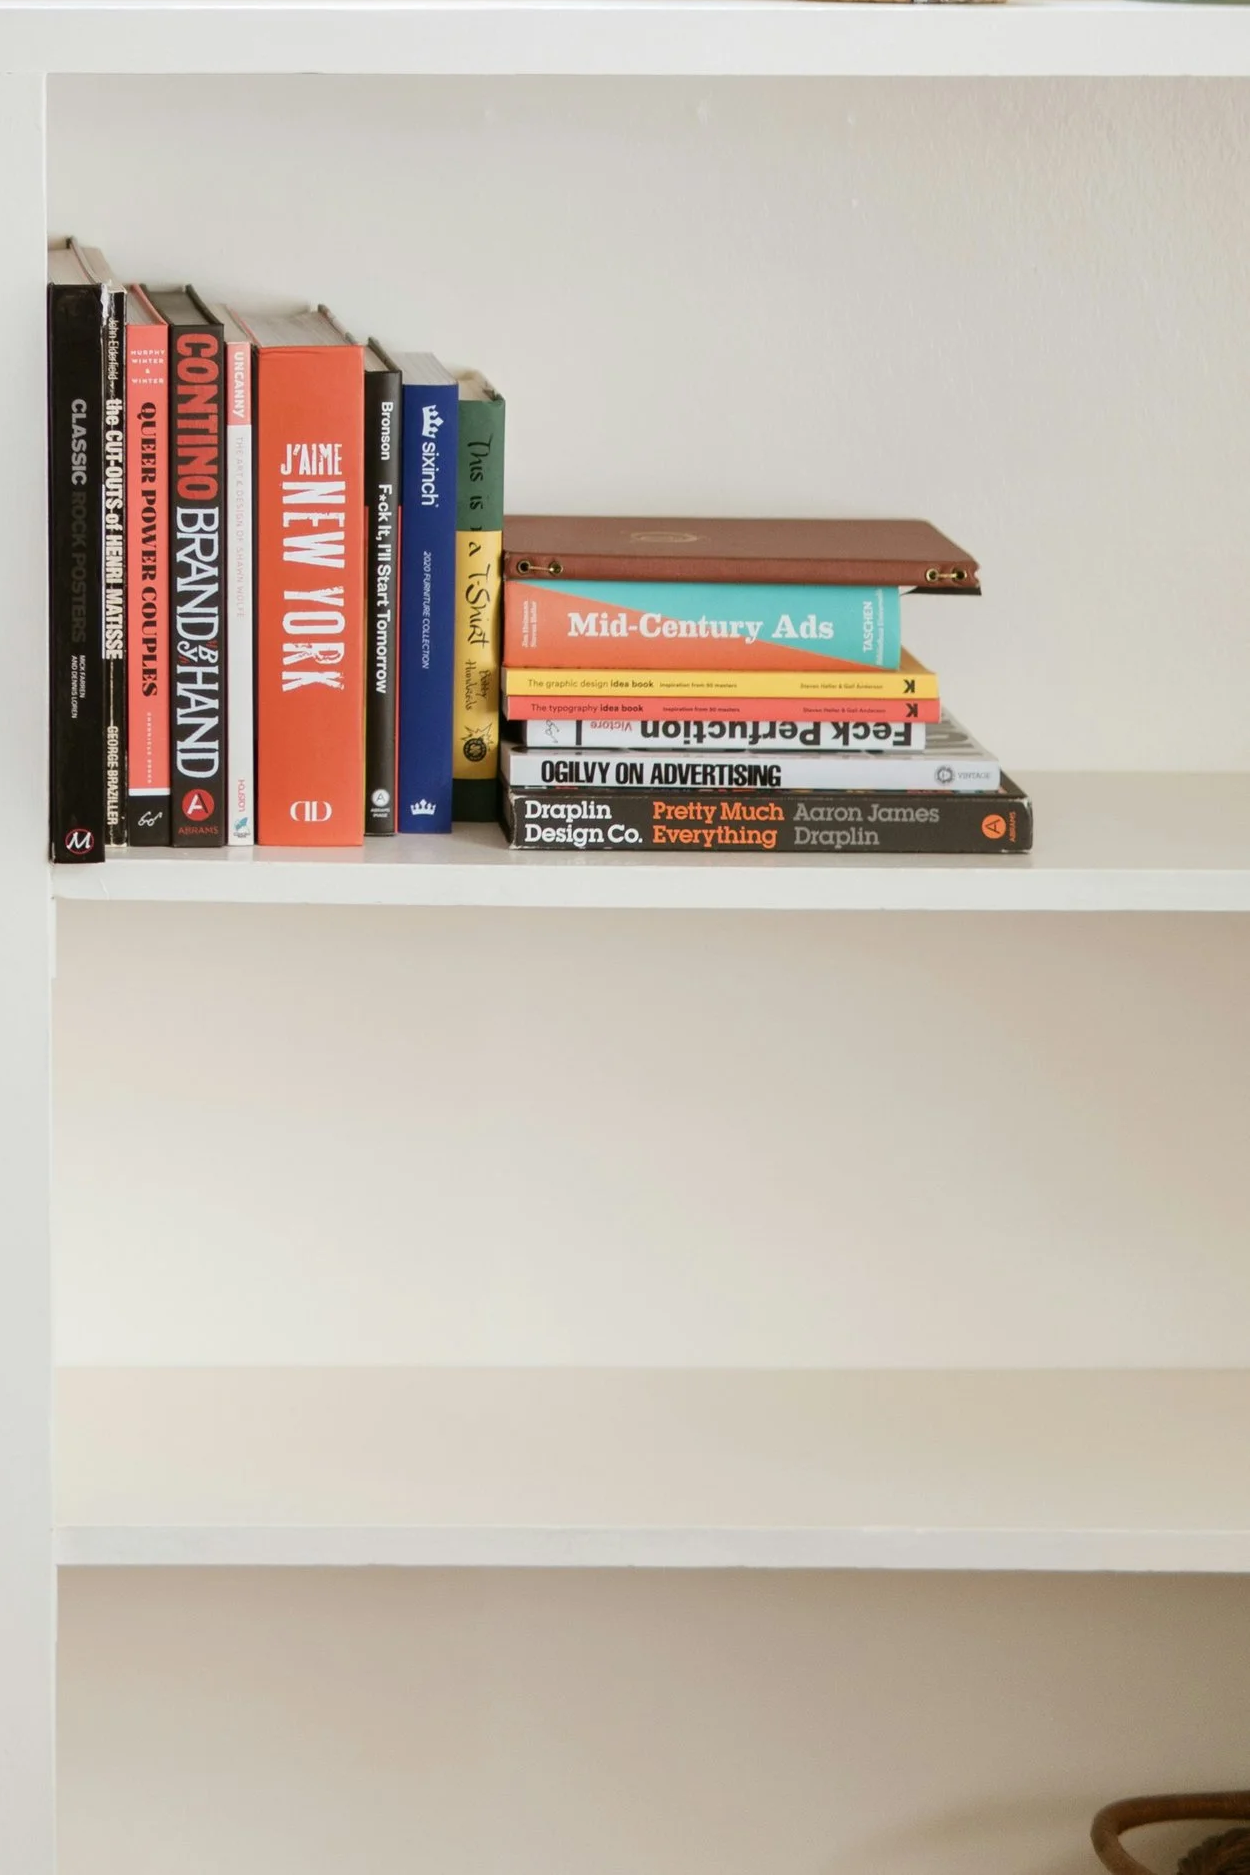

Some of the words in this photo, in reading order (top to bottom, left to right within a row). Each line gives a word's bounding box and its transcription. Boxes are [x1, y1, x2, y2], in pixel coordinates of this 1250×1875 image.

[108, 317, 120, 338] John
[108, 340, 120, 380] Elderfield
[105, 398, 123, 425] the
[176, 332, 219, 499] CONTINO
[380, 401, 393, 461] Bronson
[70, 398, 88, 486] CLASSIC
[136, 401, 158, 484] QUEER
[467, 433, 493, 483] This
[105, 430, 123, 508] CUT-OUTS
[420, 441, 439, 505] sixinch
[70, 490, 88, 548] ROCK
[105, 512, 123, 531] of
[469, 495, 489, 510] is
[141, 489, 158, 581] POWER
[281, 481, 346, 569] NEW
[375, 525, 392, 541] It,
[105, 534, 123, 584] HENRI
[423, 550, 432, 572] 2020
[467, 541, 484, 556] a
[176, 506, 219, 642] BRAND
[376, 567, 392, 607] Start
[70, 552, 88, 643] POSTERS
[422, 573, 431, 617] FURNITURE
[105, 588, 124, 660] MATISSE
[141, 586, 158, 697] COUPLES
[281, 586, 346, 692] YORK
[421, 618, 430, 669] COLLECTION
[567, 612, 763, 645] Mid-Century
[772, 614, 835, 639] Ads
[862, 601, 873, 653] TASCHEN
[78, 654, 87, 672] MICK
[375, 609, 392, 694] Tomorrow
[78, 673, 87, 698] FARREN
[528, 679, 544, 687] The
[545, 679, 578, 690] graphic
[580, 679, 609, 690] design
[610, 679, 630, 688] idea
[631, 680, 654, 688] book
[176, 665, 219, 778] HAND
[531, 703, 547, 712] The
[549, 704, 598, 714] typography
[600, 703, 620, 712] idea
[621, 704, 643, 713] book
[107, 725, 119, 767] GEORGE
[639, 719, 821, 746] Perfuction
[831, 721, 912, 746] Feck
[541, 760, 611, 784] OGILVY
[615, 761, 644, 785] ON
[650, 762, 782, 787] ADVERTISING
[957, 771, 991, 780] VINTAGE
[107, 769, 119, 826] BRAZILLER
[524, 800, 612, 823] Draplin
[653, 801, 717, 823] Pretty
[720, 801, 784, 821] Much
[793, 803, 863, 822] Aaron
[867, 803, 940, 822] James
[178, 826, 219, 836] ABRAMS
[524, 824, 604, 846] Design
[607, 824, 643, 843] Co.
[653, 825, 778, 848] Everything
[794, 827, 880, 848] Draplin
